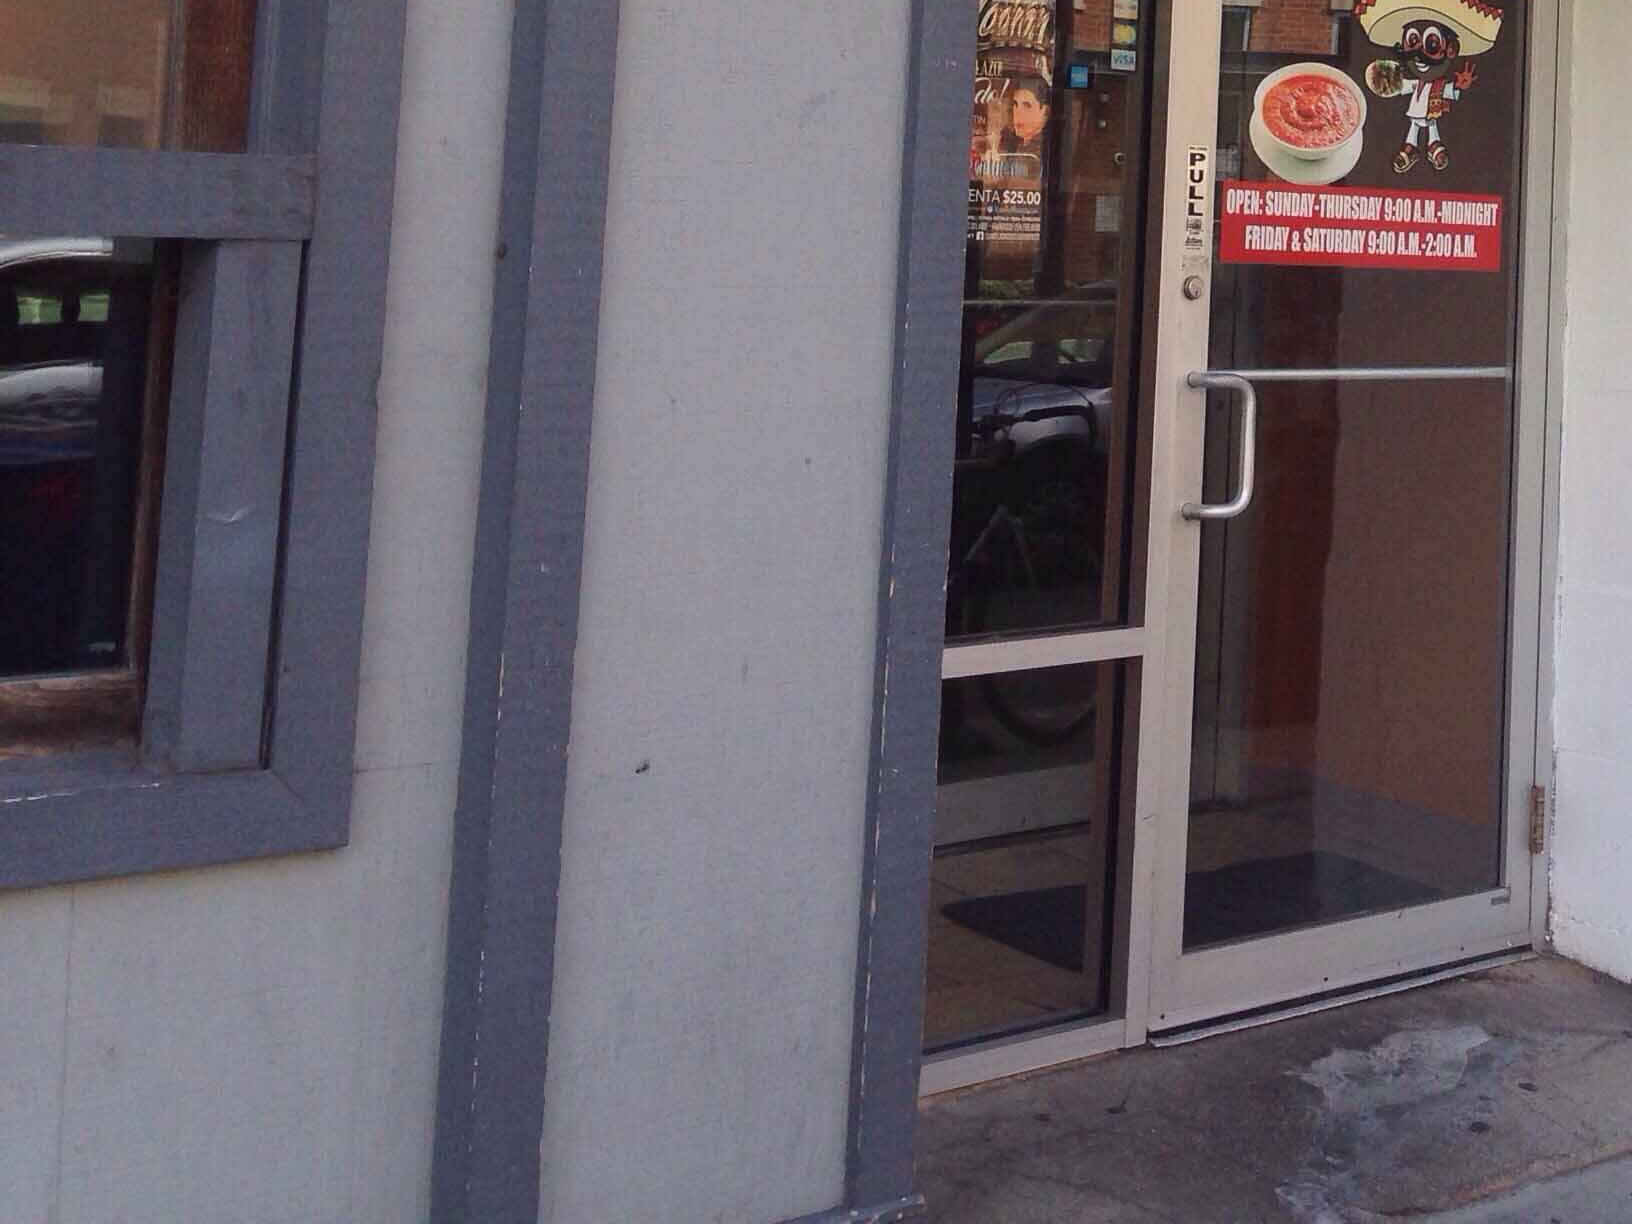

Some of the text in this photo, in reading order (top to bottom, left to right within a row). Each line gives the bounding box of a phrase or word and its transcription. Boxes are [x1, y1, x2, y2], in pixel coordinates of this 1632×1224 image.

[1003, 190, 1041, 205] $25.00
[1188, 152, 1206, 217] PULL
[1226, 189, 1263, 215] OPEN:
[1265, 191, 1383, 221] SUNDAY-THURSDAY
[1384, 198, 1412, 223] 9:00
[1245, 225, 1290, 252] FRIDAY
[1292, 230, 1301, 252] &
[1303, 228, 1366, 254] SATURDAY
[1368, 230, 1395, 255] 9:00
[1453, 234, 1478, 258] A.M.
